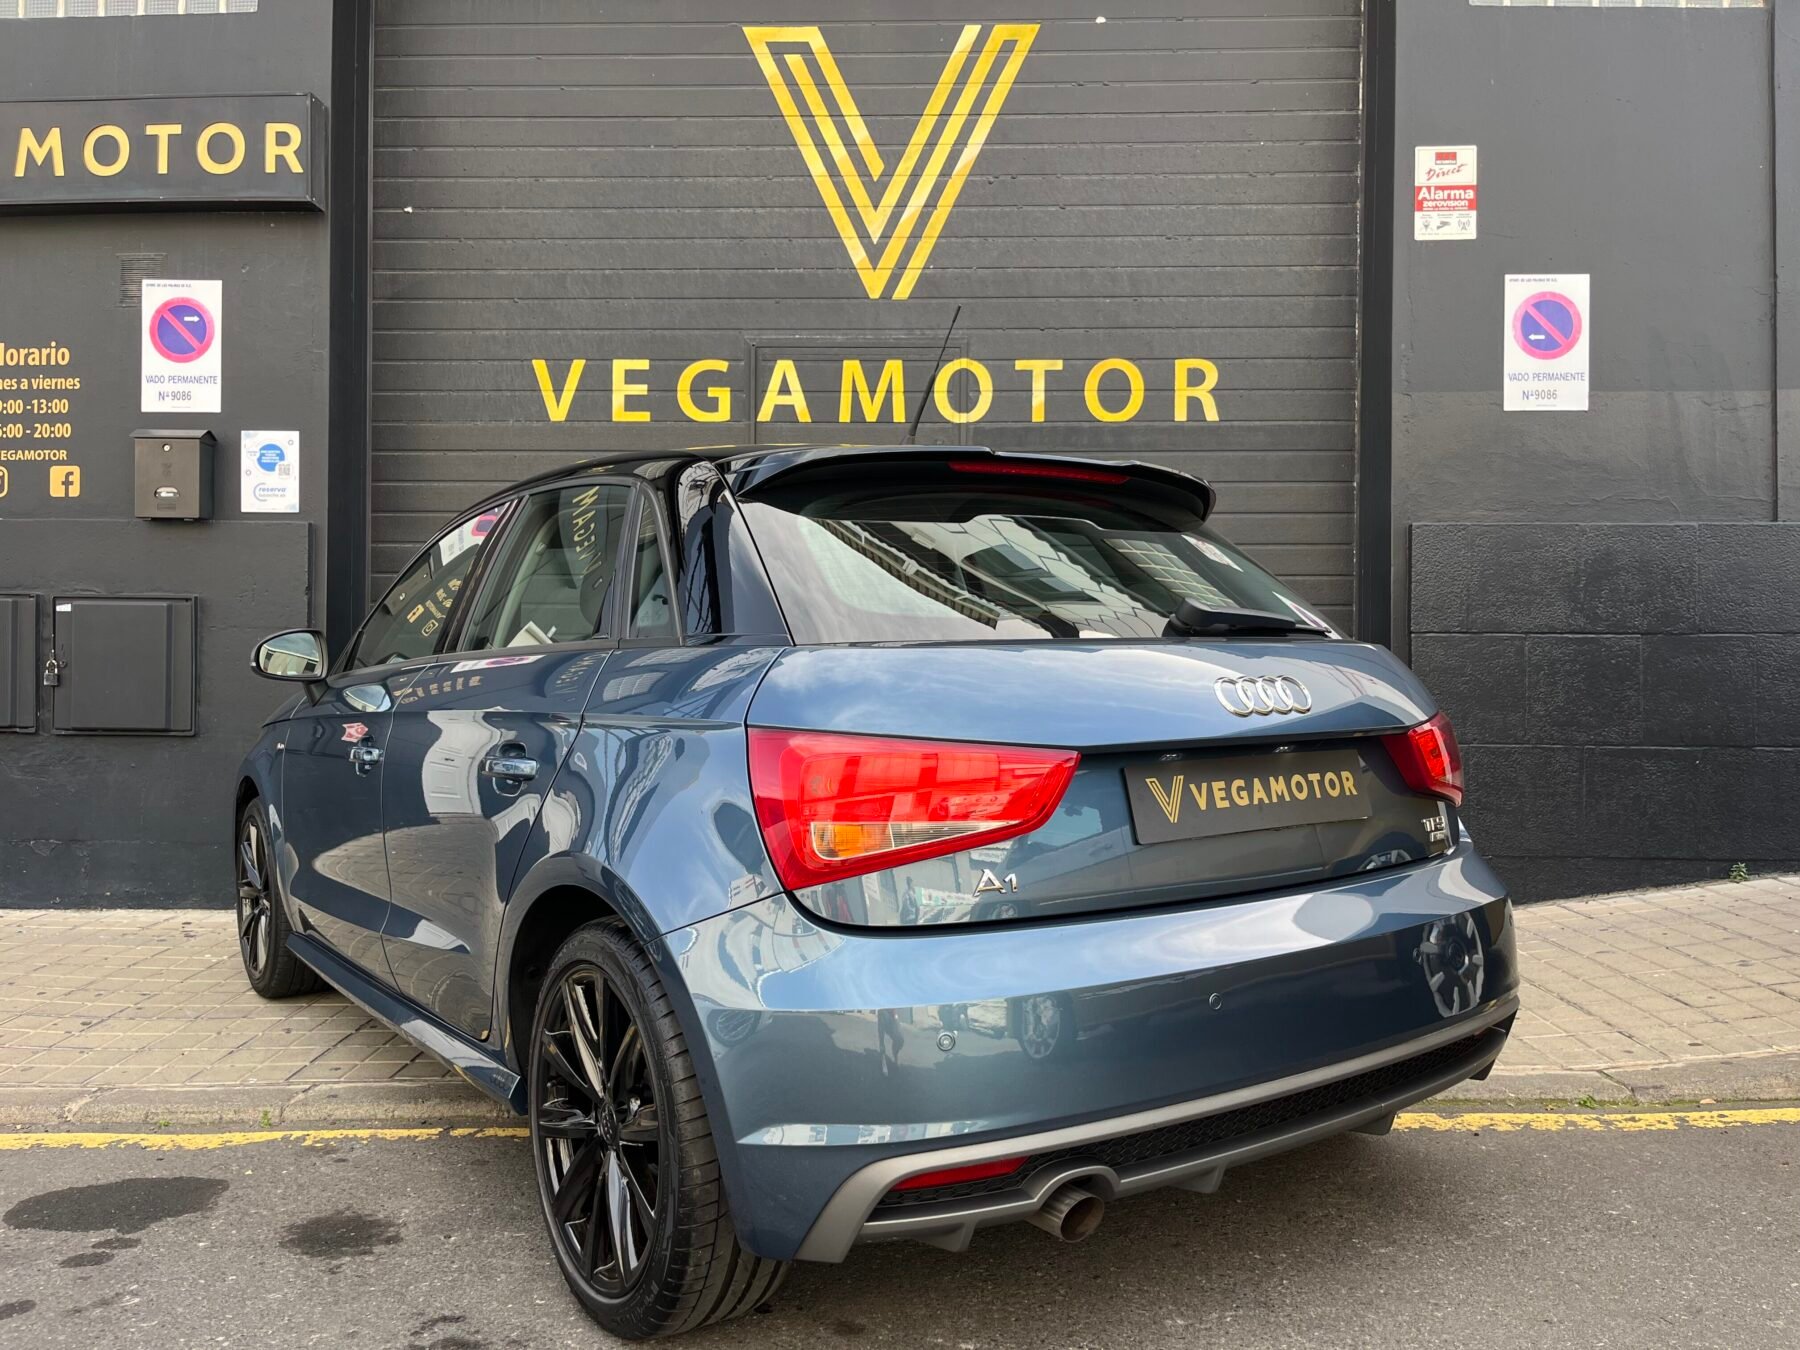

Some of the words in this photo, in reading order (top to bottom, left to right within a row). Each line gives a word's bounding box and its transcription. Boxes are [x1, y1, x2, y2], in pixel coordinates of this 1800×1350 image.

[14, 122, 304, 178] MOTOR
[1418, 186, 1474, 200] Alarma
[20, 378, 28, 390] a
[31, 374, 80, 390] viernes
[145, 375, 166, 384] VADO
[167, 375, 218, 384] PERMANENTE
[1508, 372, 1530, 381] VADO
[1532, 372, 1586, 381] PERMANENTE
[531, 357, 1220, 424] VEGAMOTOR
[33, 423, 71, 438] 20:00
[0, 449, 67, 461] EGAMOTOR
[1189, 771, 1358, 811] VEGAMOTOR
[973, 868, 1018, 897] A1
